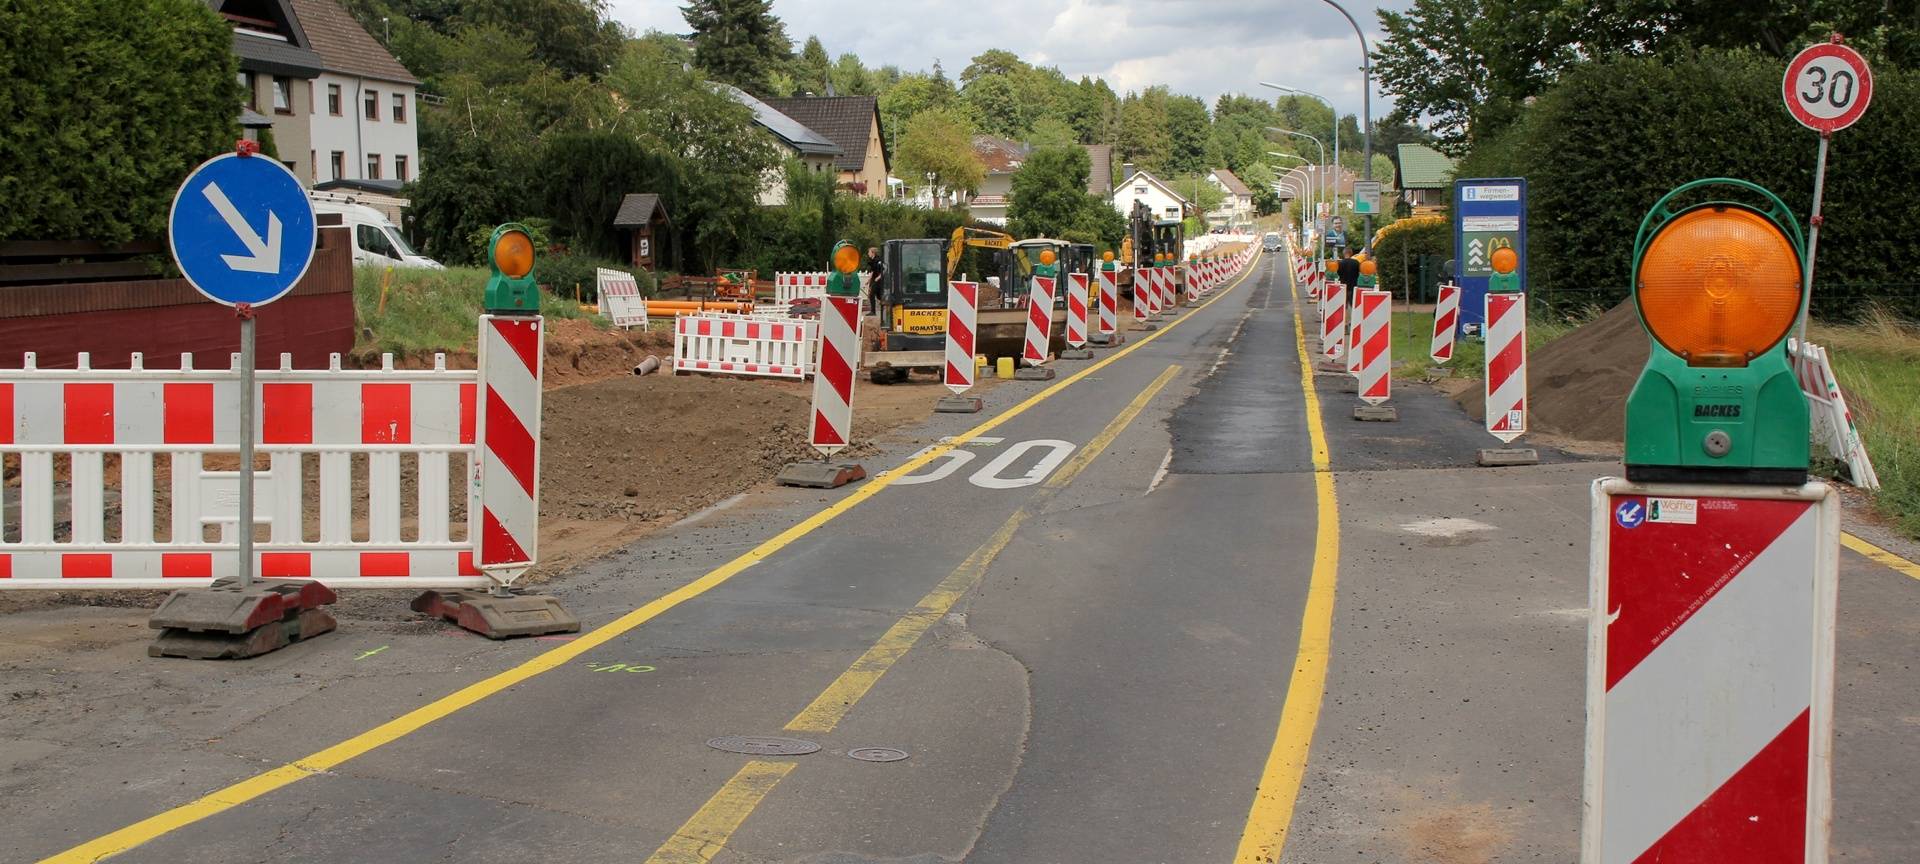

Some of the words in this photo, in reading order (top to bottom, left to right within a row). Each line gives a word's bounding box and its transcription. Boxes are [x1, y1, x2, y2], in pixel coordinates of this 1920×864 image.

[1802, 66, 1853, 108] 30
[1694, 405, 1741, 417] BACKES
[873, 436, 1077, 489] 50
